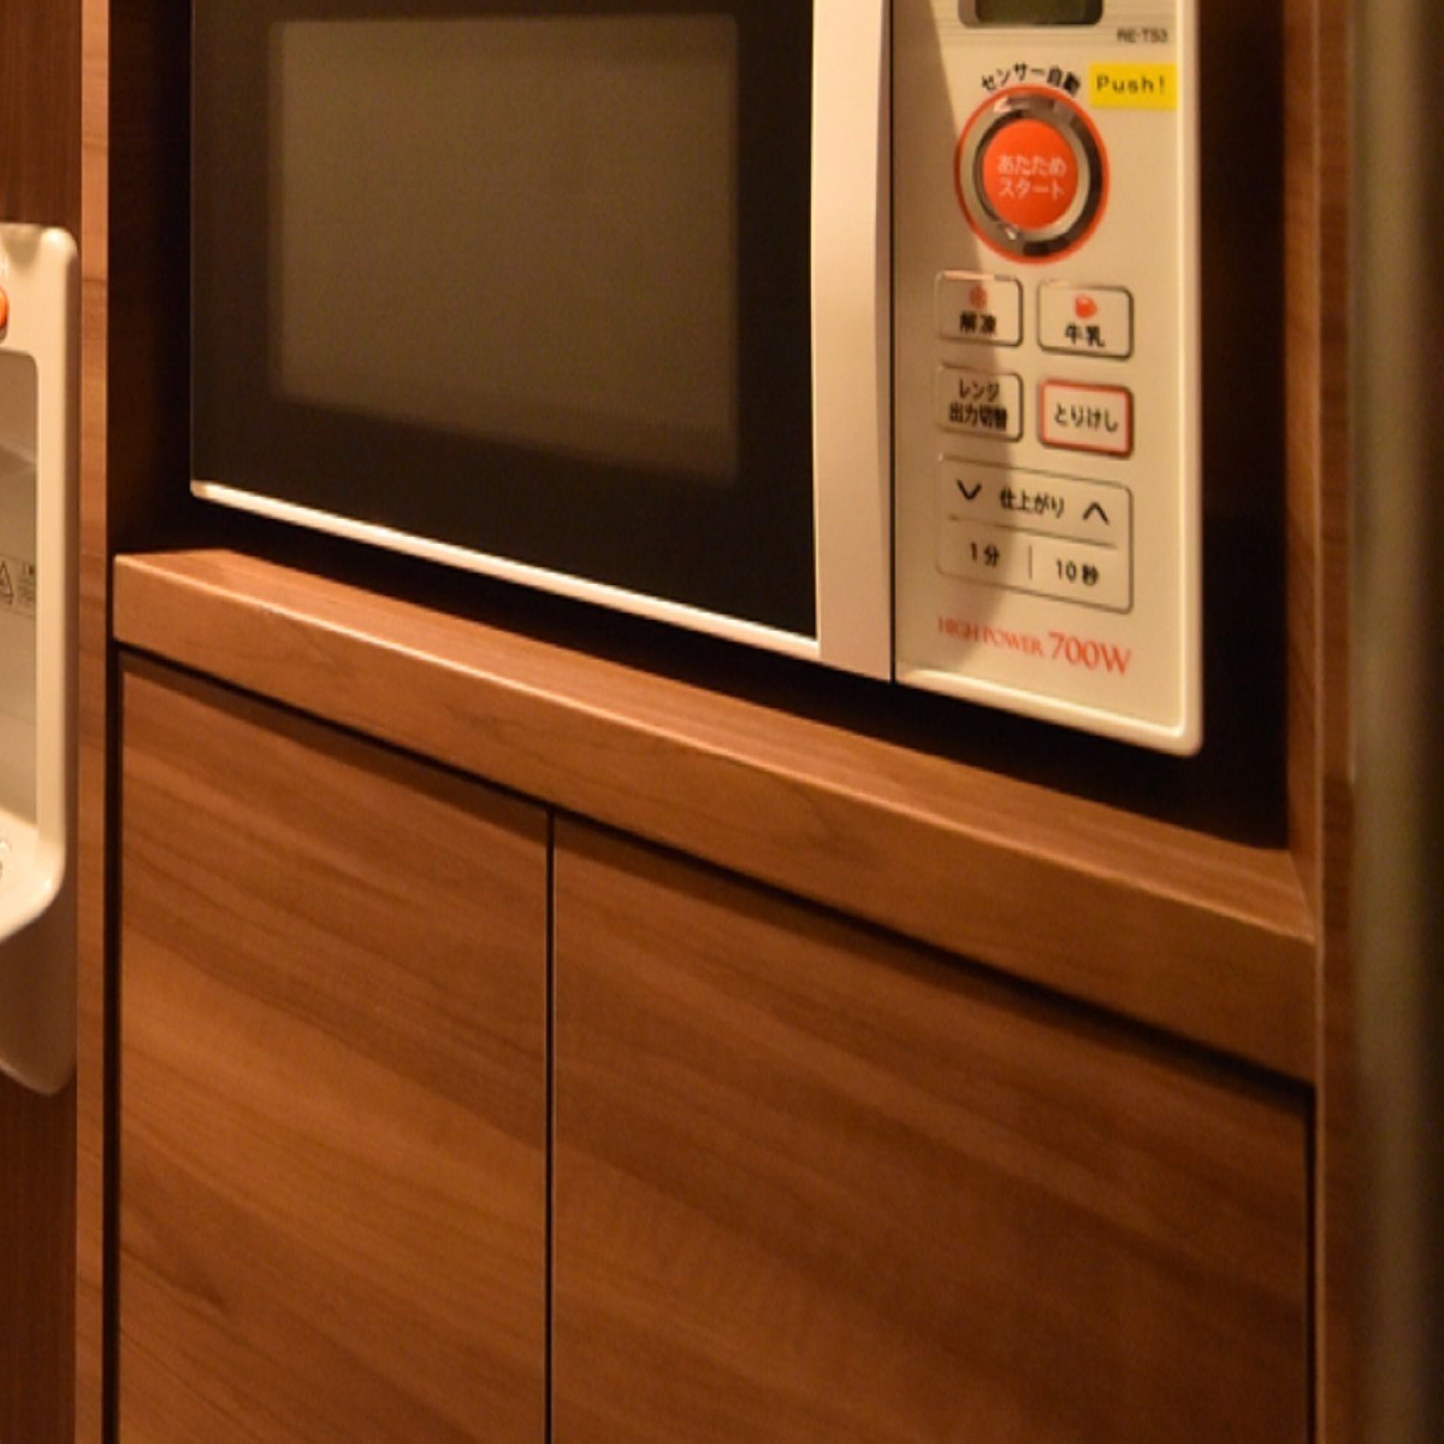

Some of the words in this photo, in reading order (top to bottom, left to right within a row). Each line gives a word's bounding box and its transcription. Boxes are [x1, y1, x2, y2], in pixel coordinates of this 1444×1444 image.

[981, 62, 1081, 96] センサー自動
[1097, 74, 1165, 94] Push!
[996, 155, 1067, 178] あたため
[1000, 178, 1065, 201] スタート
[1064, 323, 1105, 348] 牛乳
[959, 379, 1000, 403] レンジ
[1054, 403, 1119, 433] とりけし
[1000, 487, 1064, 519] 仕上がり
[983, 625, 1044, 657] POWER
[1048, 631, 1132, 676] 700W
